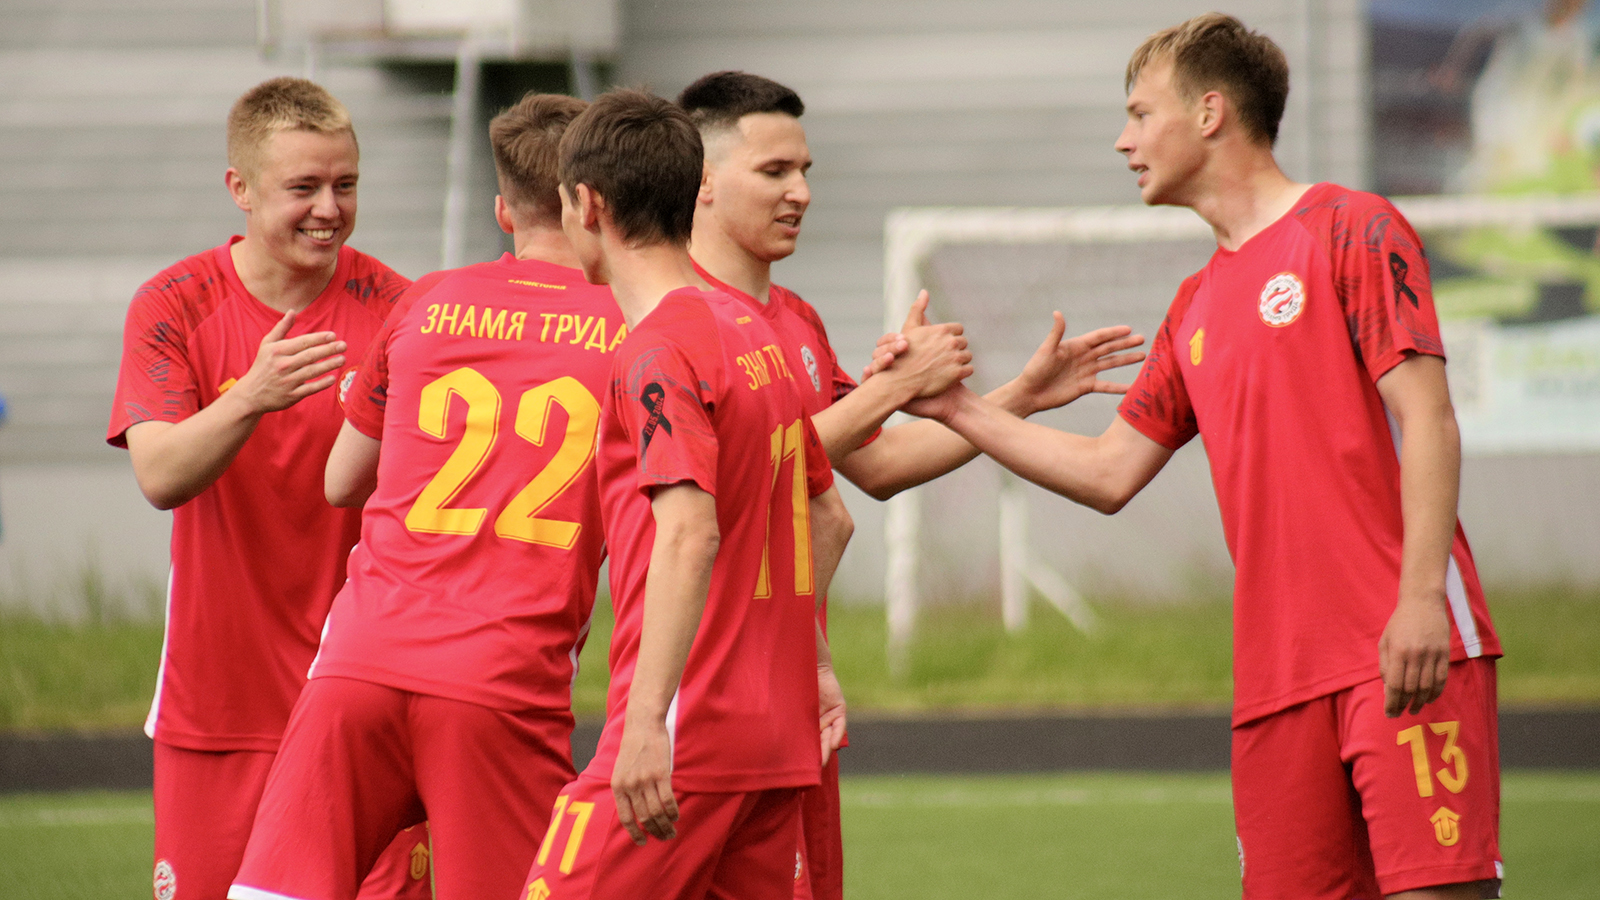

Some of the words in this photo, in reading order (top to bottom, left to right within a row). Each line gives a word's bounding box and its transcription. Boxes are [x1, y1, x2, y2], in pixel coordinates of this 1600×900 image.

[420, 303, 528, 341] ЗНАМЯ
[540, 313, 627, 354] ТРУДА
[404, 367, 602, 551] 22
[753, 418, 814, 599] 11
[1396, 721, 1469, 797] 13
[537, 794, 595, 875] 11
